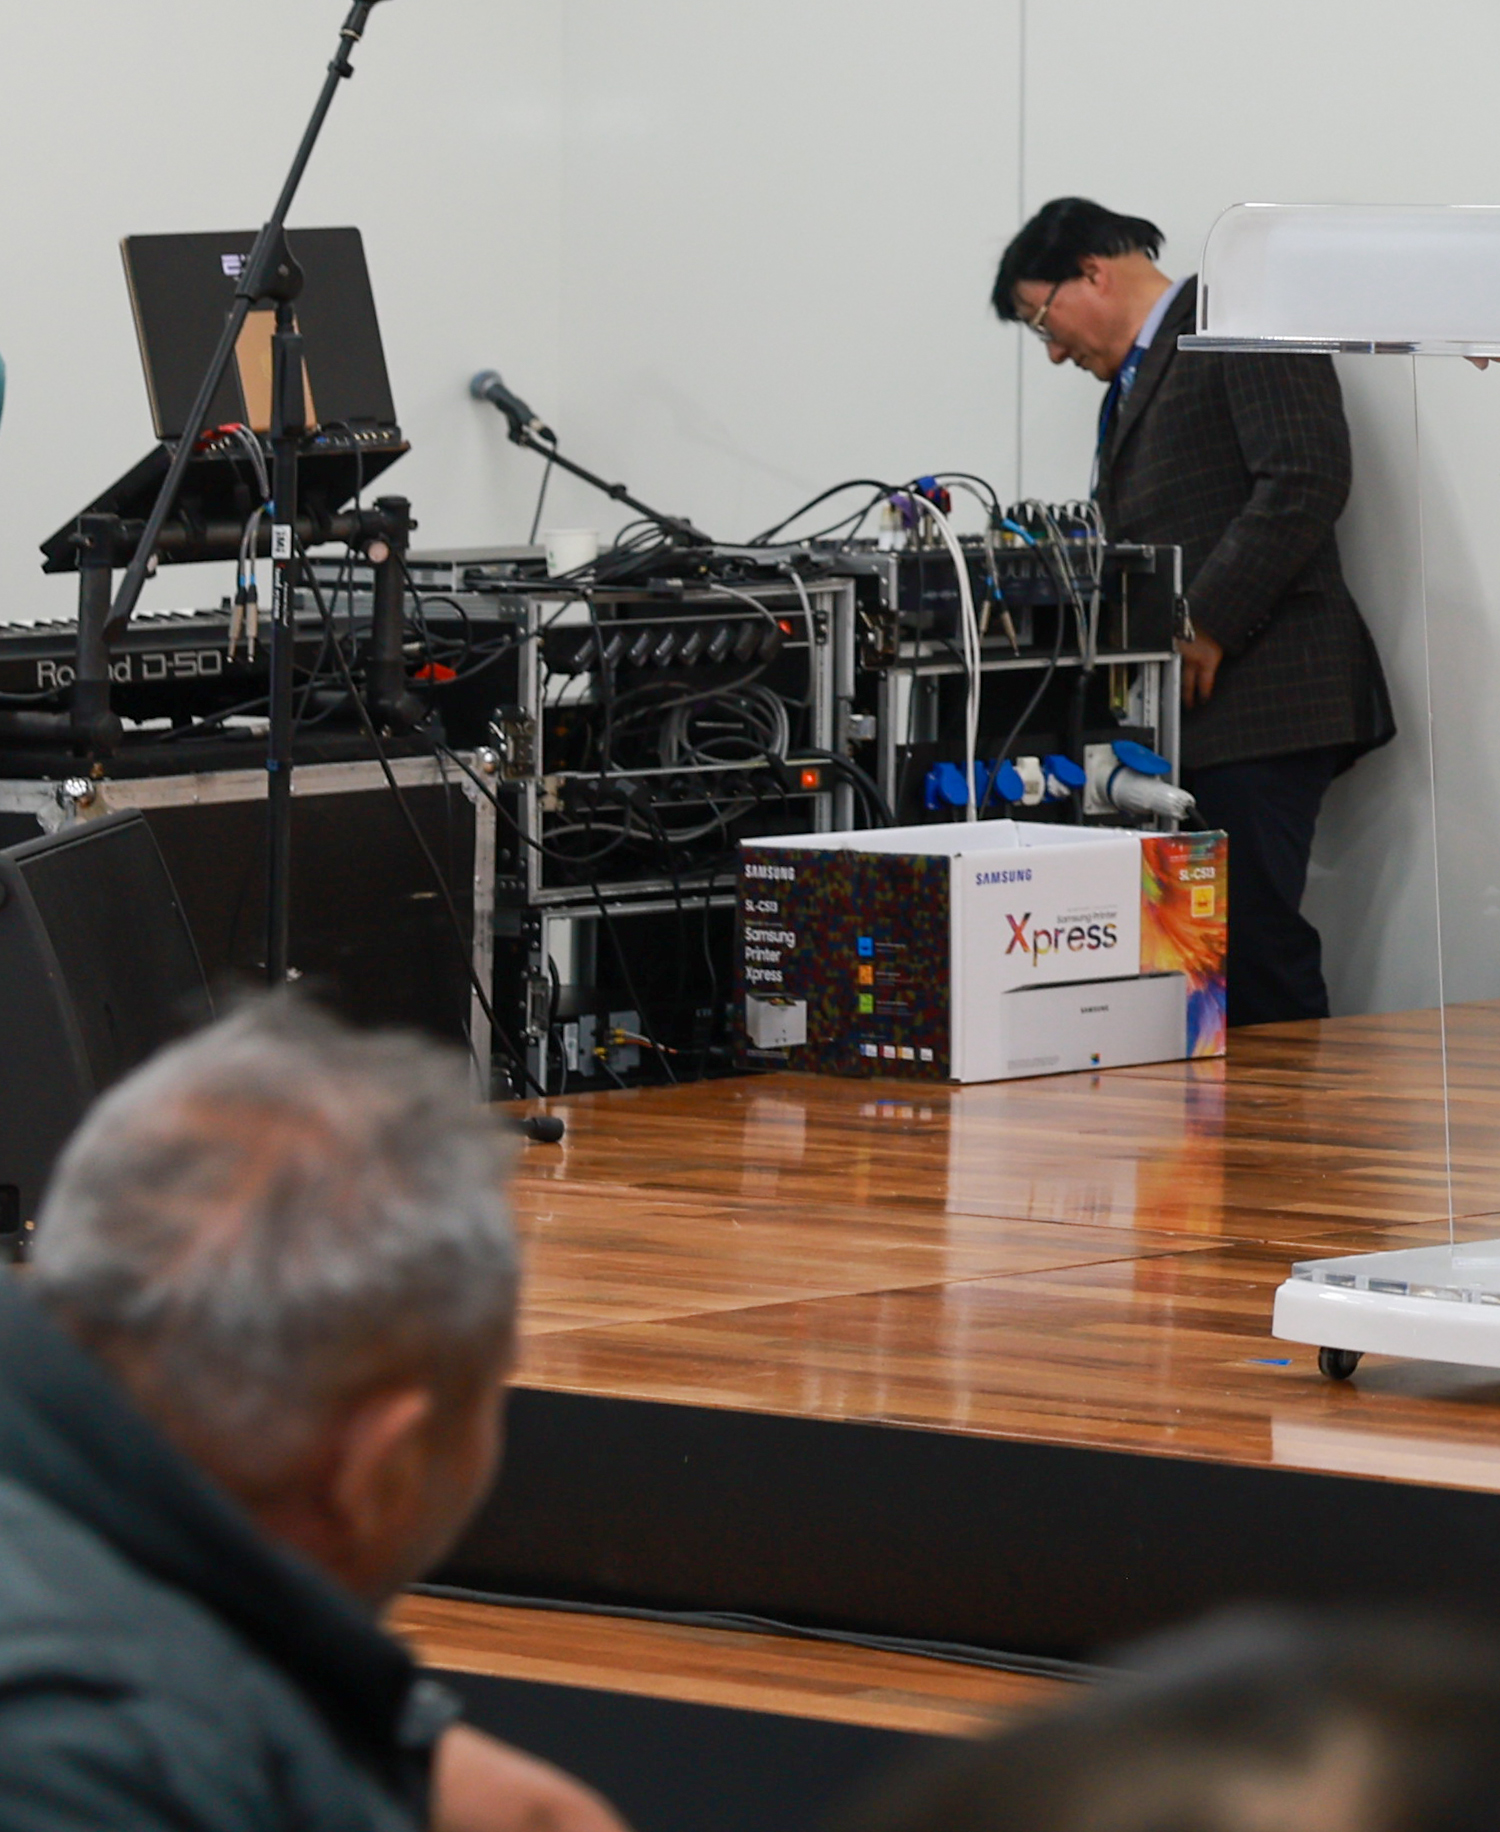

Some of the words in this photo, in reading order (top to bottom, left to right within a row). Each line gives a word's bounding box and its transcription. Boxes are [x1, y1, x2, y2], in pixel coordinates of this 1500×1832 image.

[37, 654, 131, 689] Rond
[142, 650, 222, 681] D-50
[745, 865, 795, 881] SAMSUNG
[976, 868, 1032, 885] SAMSUNG
[745, 927, 795, 948] Samsung
[1005, 912, 1117, 967] Xpress
[745, 947, 781, 962] Printer
[745, 966, 783, 984] Xpress
